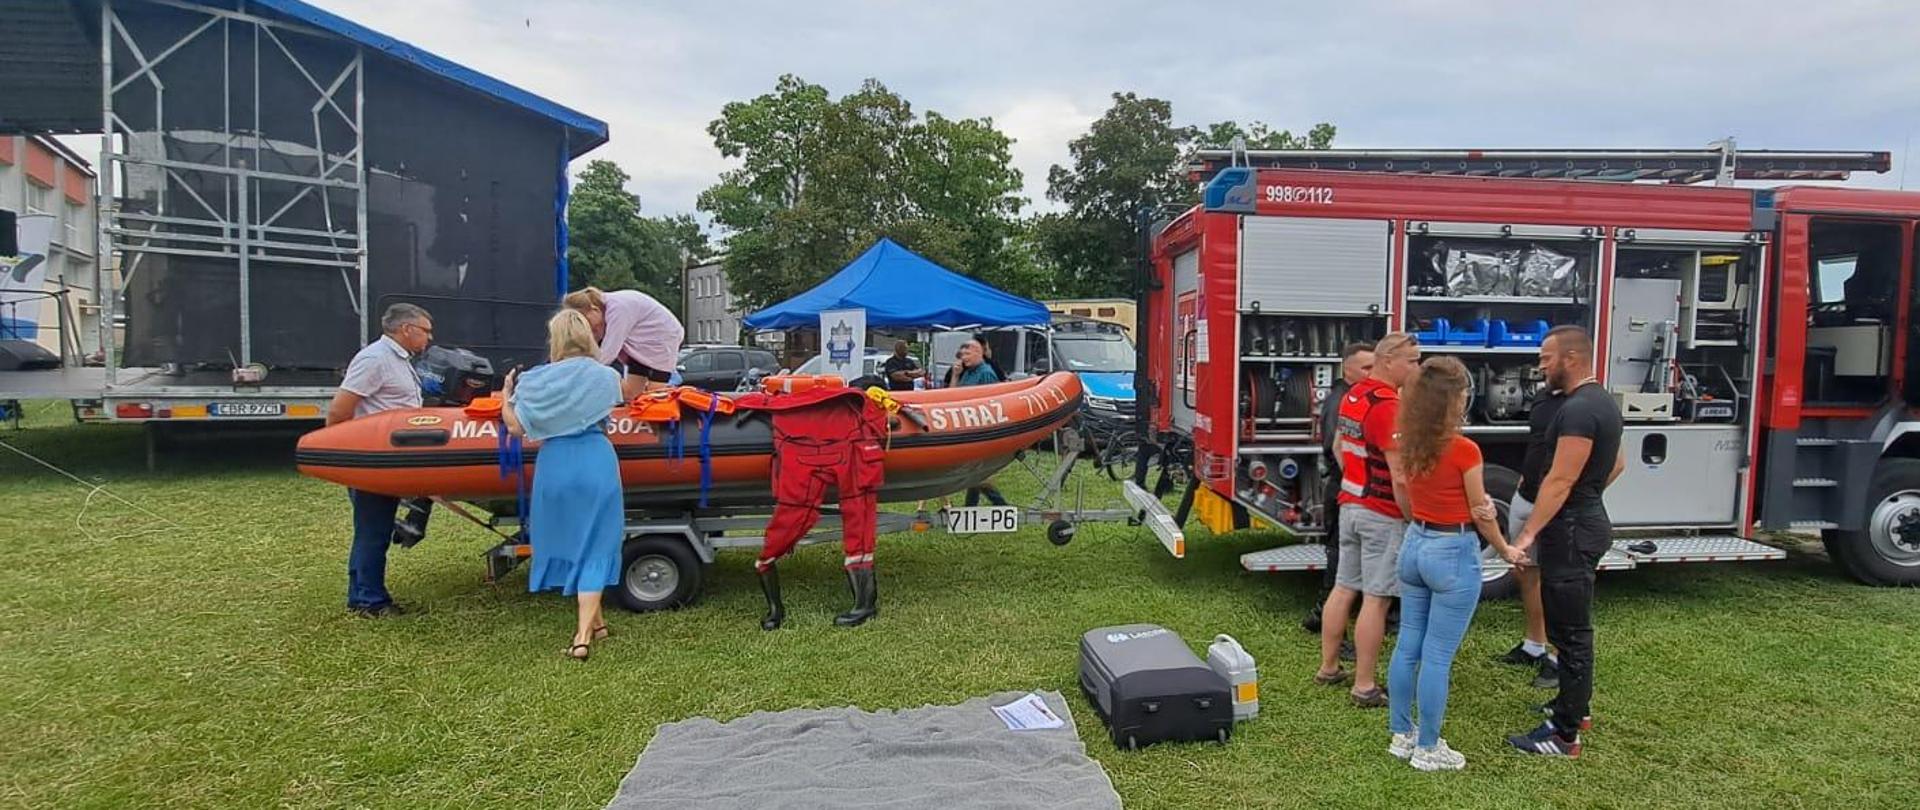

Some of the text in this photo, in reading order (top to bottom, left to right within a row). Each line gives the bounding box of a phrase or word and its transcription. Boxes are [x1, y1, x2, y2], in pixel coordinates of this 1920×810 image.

[1265, 185, 1292, 203] 998
[1307, 186, 1334, 205] 112
[950, 508, 1016, 532] 711-P6
